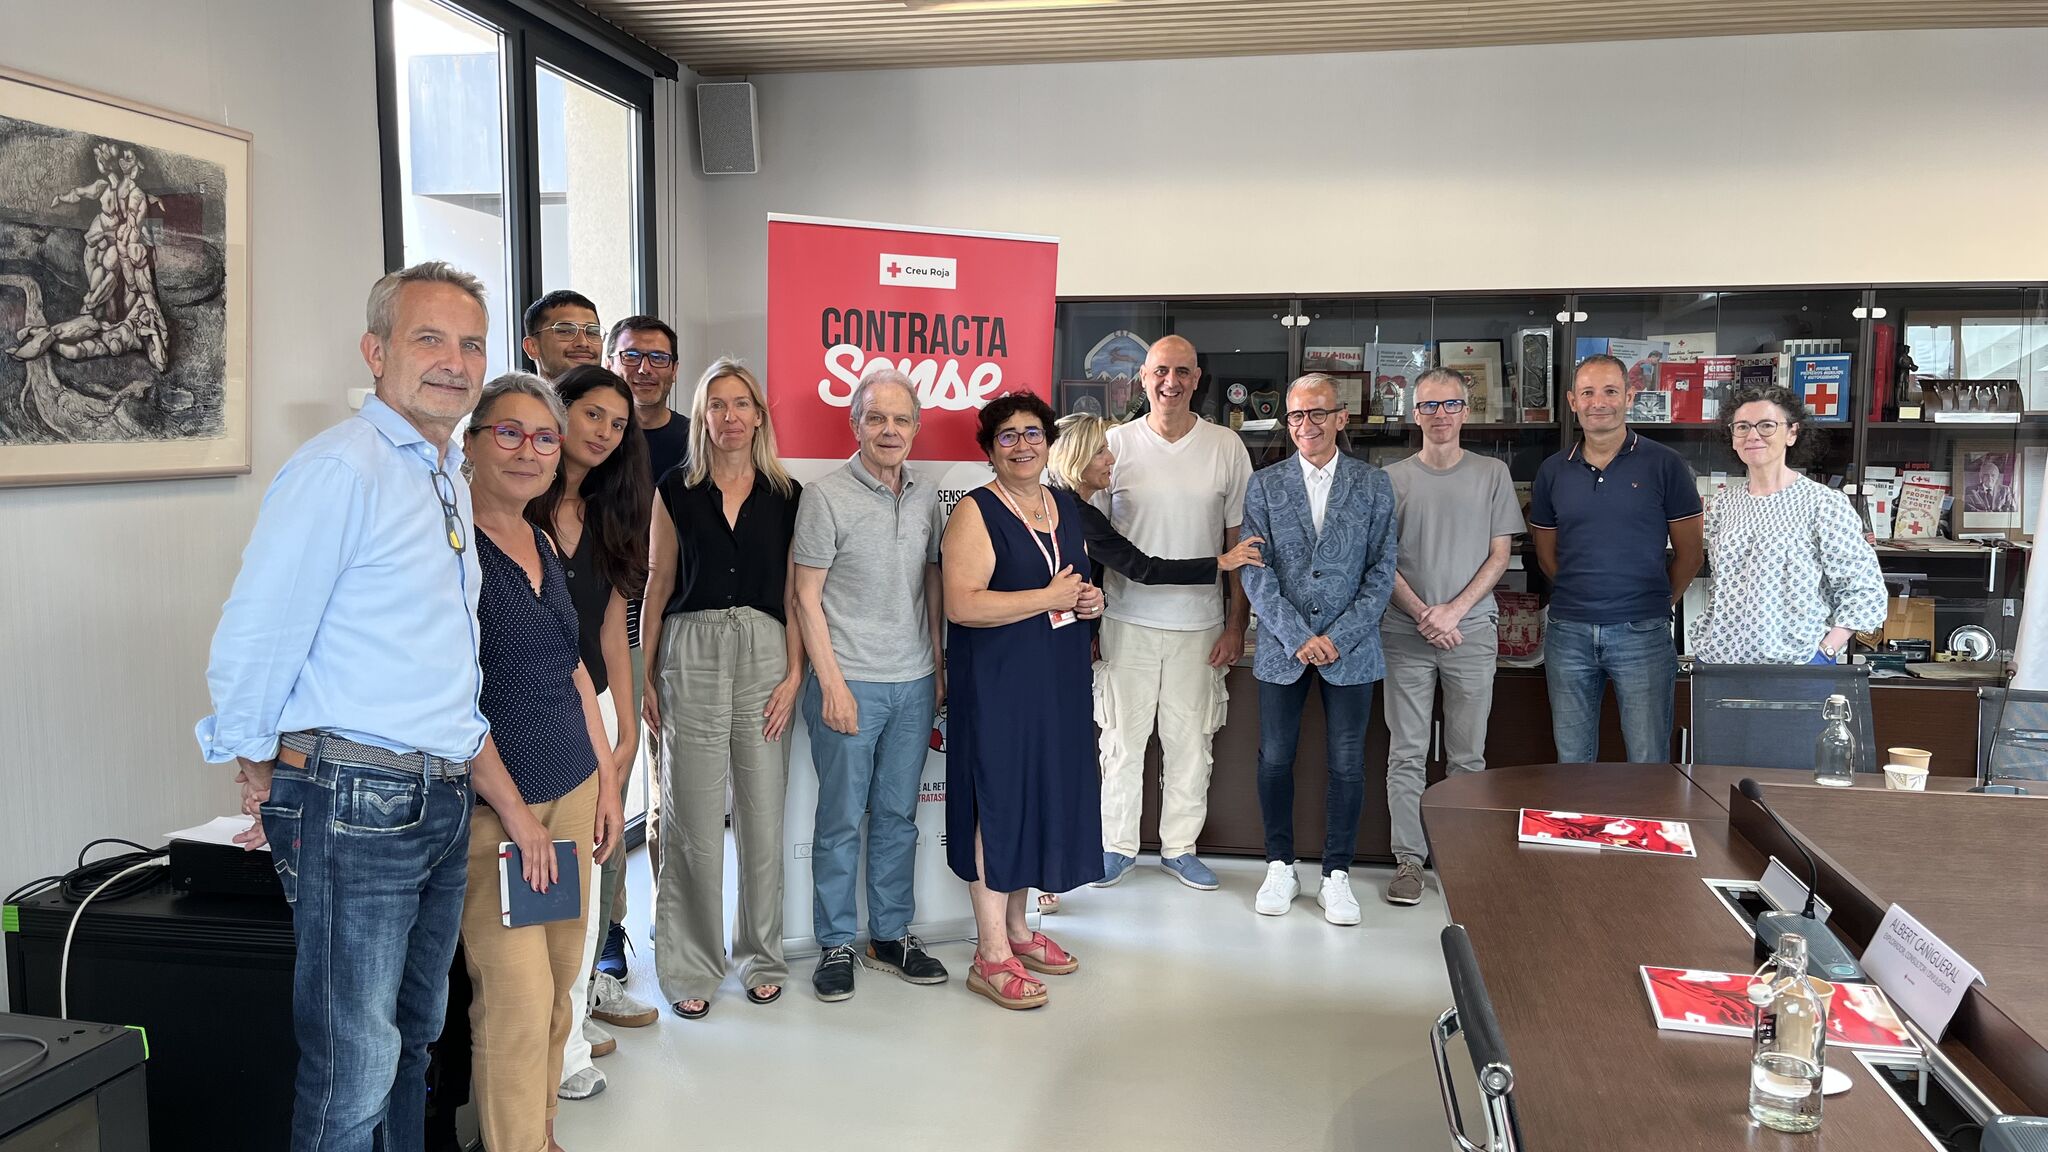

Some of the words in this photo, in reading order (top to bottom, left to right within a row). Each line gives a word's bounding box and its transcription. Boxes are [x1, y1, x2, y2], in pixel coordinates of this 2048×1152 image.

[905, 266, 928, 275] Creu
[930, 268, 950, 278] Roja
[821, 307, 1008, 357] CONTRACTA
[923, 782, 931, 791] AL
[1890, 919, 1918, 945] ALBERT
[1914, 938, 1960, 984] CAÑIGUERAL
